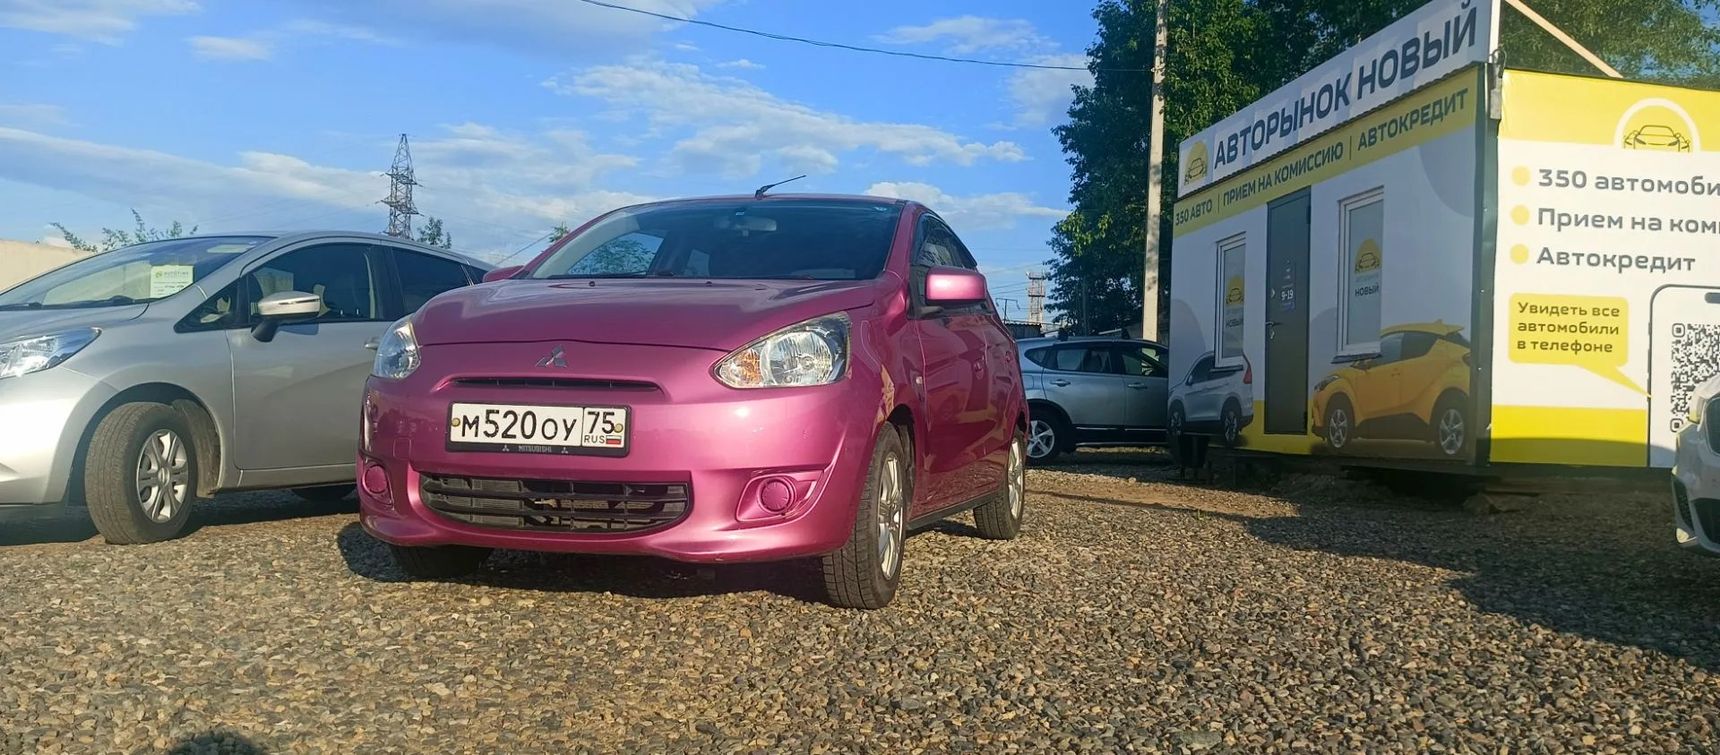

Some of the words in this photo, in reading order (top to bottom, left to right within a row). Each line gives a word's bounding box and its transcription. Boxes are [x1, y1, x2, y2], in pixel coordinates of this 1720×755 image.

[1214, 71, 1352, 169] АВТОРЫНОК
[1356, 0, 1477, 99] НОВЫЙ
[1175, 211, 1190, 226] 350
[1190, 199, 1213, 219] АВТО
[1223, 181, 1256, 206] ПРИЕМ
[1258, 174, 1273, 193] НА
[1274, 141, 1344, 183] КОМИССИЮ
[1357, 87, 1469, 151] АВТОКРЕДИТ
[1538, 168, 1588, 189] 350
[1538, 207, 1624, 233] Прием
[1631, 216, 1662, 232] на
[1669, 218, 1720, 235] ком
[1536, 246, 1696, 275] Автокредит
[1517, 301, 1588, 317] Увидеть
[1592, 306, 1621, 317] все
[1517, 321, 1620, 335] автомобили
[1517, 340, 1526, 350] в
[1530, 339, 1613, 355] телефоне
[587, 411, 615, 435] 75
[584, 434, 606, 445] RUS
